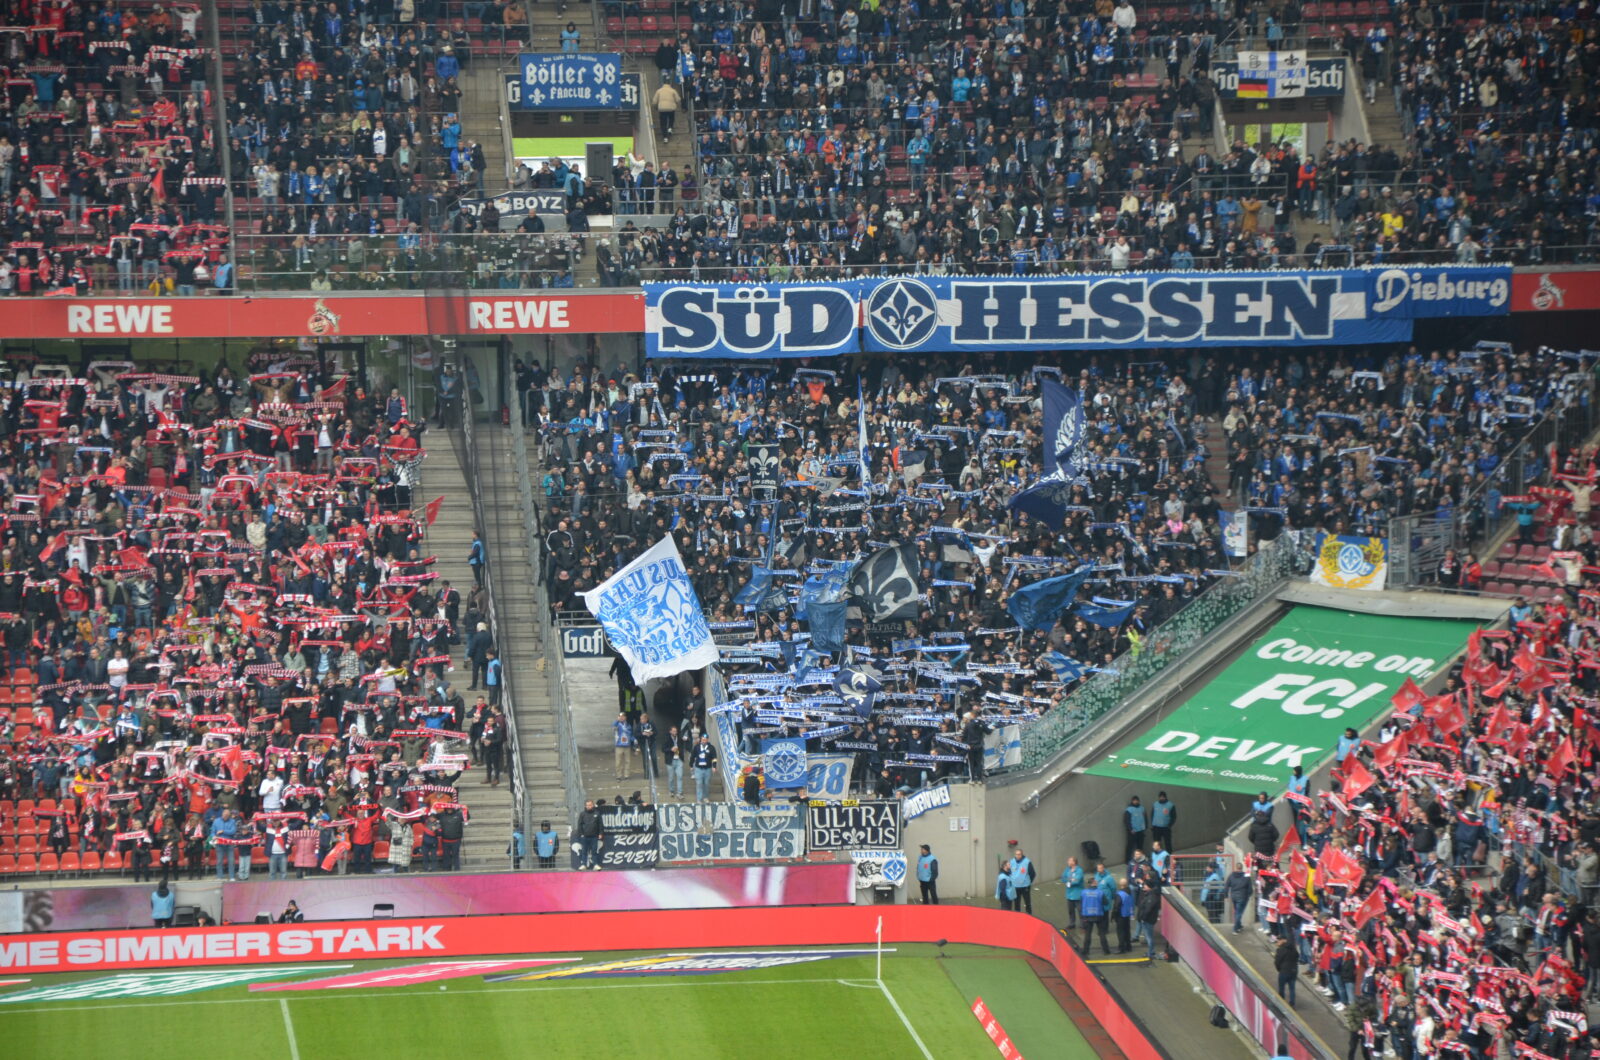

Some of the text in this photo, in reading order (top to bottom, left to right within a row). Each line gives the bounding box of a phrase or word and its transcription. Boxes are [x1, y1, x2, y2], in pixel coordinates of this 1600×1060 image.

[525, 62, 616, 85] Böller 98
[550, 86, 592, 99] FANCLUB
[513, 196, 562, 211] BOYZ
[1372, 269, 1509, 312] Dieburg
[67, 304, 174, 333] REWE
[469, 300, 570, 330] REWE
[658, 275, 1342, 353] SÜD HESSEN
[1256, 637, 1376, 669] Come
[1230, 673, 1388, 719] FC!
[1145, 730, 1323, 767] DEVK
[807, 761, 848, 795] 98
[602, 805, 654, 832] underdogs
[659, 804, 752, 832] USUAL
[812, 801, 896, 828] ULTRA
[613, 833, 654, 847] ROW
[661, 831, 795, 860] SUSPECTS
[814, 827, 896, 846] DE LIS
[602, 849, 658, 865] SEVEN
[66, 932, 271, 965] SIMMER
[277, 925, 446, 955] STARK
